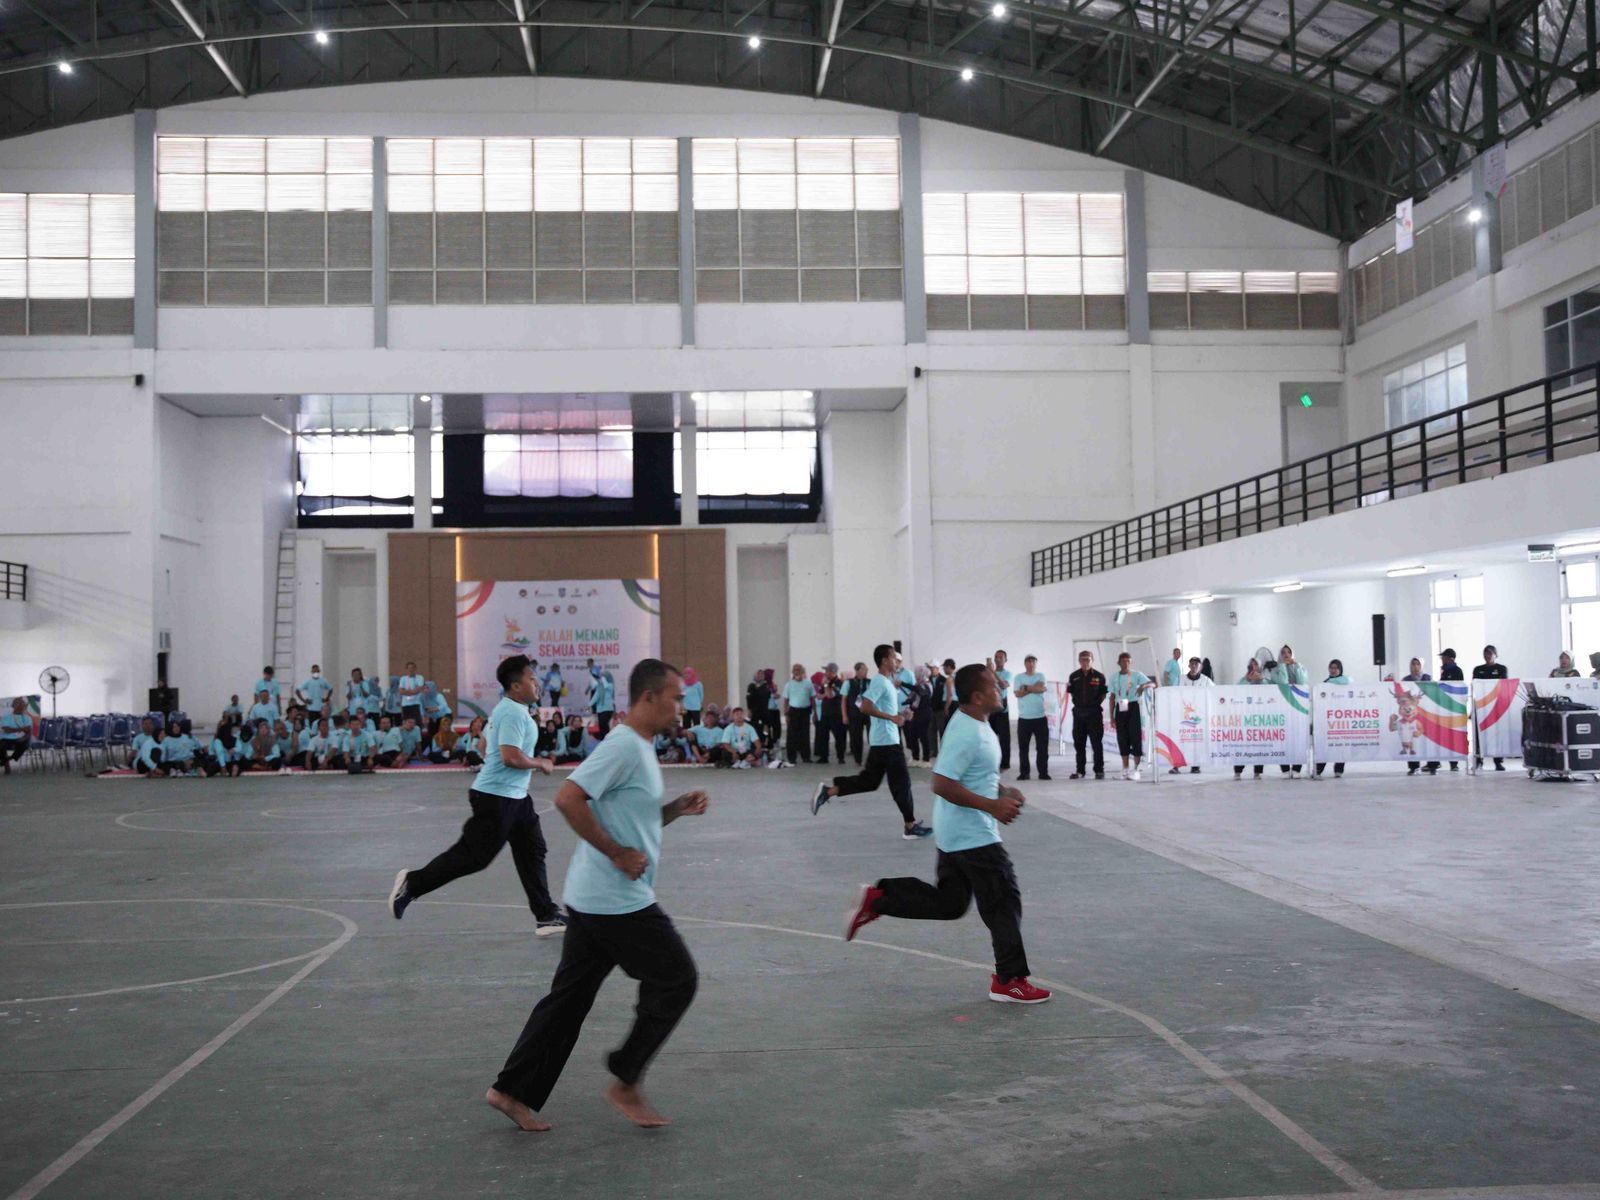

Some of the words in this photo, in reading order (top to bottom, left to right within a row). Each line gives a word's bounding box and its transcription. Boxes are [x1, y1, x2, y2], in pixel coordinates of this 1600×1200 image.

[538, 629, 573, 642] KALAH
[575, 628, 619, 641] MENANG
[539, 644, 575, 657] SEMUA
[577, 643, 620, 656] SENANG
[1210, 714, 1242, 727] KALAH
[1244, 714, 1285, 726] MENANG
[1327, 709, 1380, 719] FORNAS
[1327, 720, 1349, 729] VIII
[1351, 719, 1380, 729] 2025
[1210, 729, 1244, 742] SEMUA
[1246, 729, 1285, 741] SENANG
